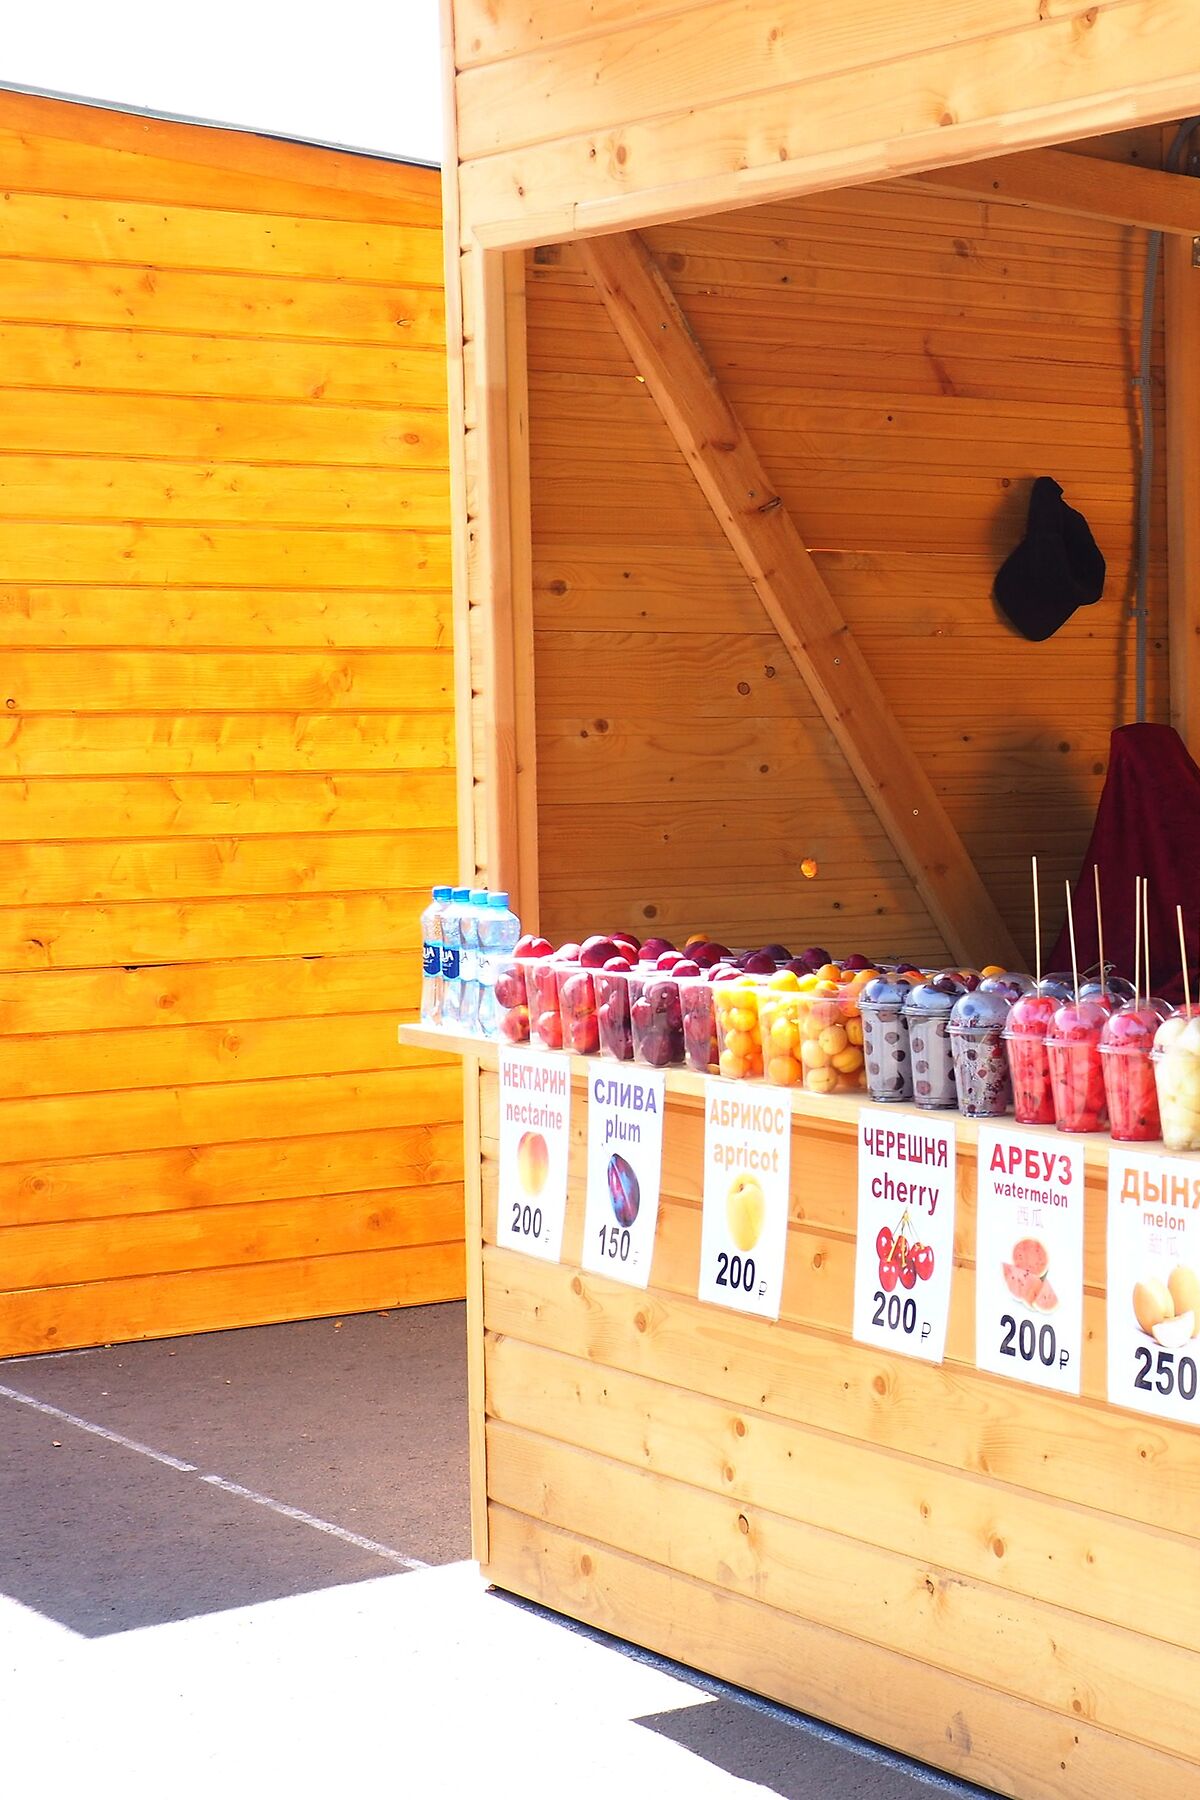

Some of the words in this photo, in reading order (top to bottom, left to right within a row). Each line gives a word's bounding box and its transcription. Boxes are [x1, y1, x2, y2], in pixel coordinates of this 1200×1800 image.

[503, 1062, 566, 1096] НЕКТАРИН
[594, 1078, 657, 1114] СЛИВА
[506, 1102, 563, 1130] nectarine
[605, 1114, 641, 1143] plum
[709, 1098, 784, 1135] АБРИКОС
[713, 1142, 779, 1174] apricot
[864, 1127, 948, 1168] ЧЕРЕШНЯ
[990, 1143, 1072, 1186] АРБУЗ
[871, 1172, 939, 1216] cherry
[994, 1180, 1068, 1208] watermelon
[1143, 1211, 1186, 1232] melon
